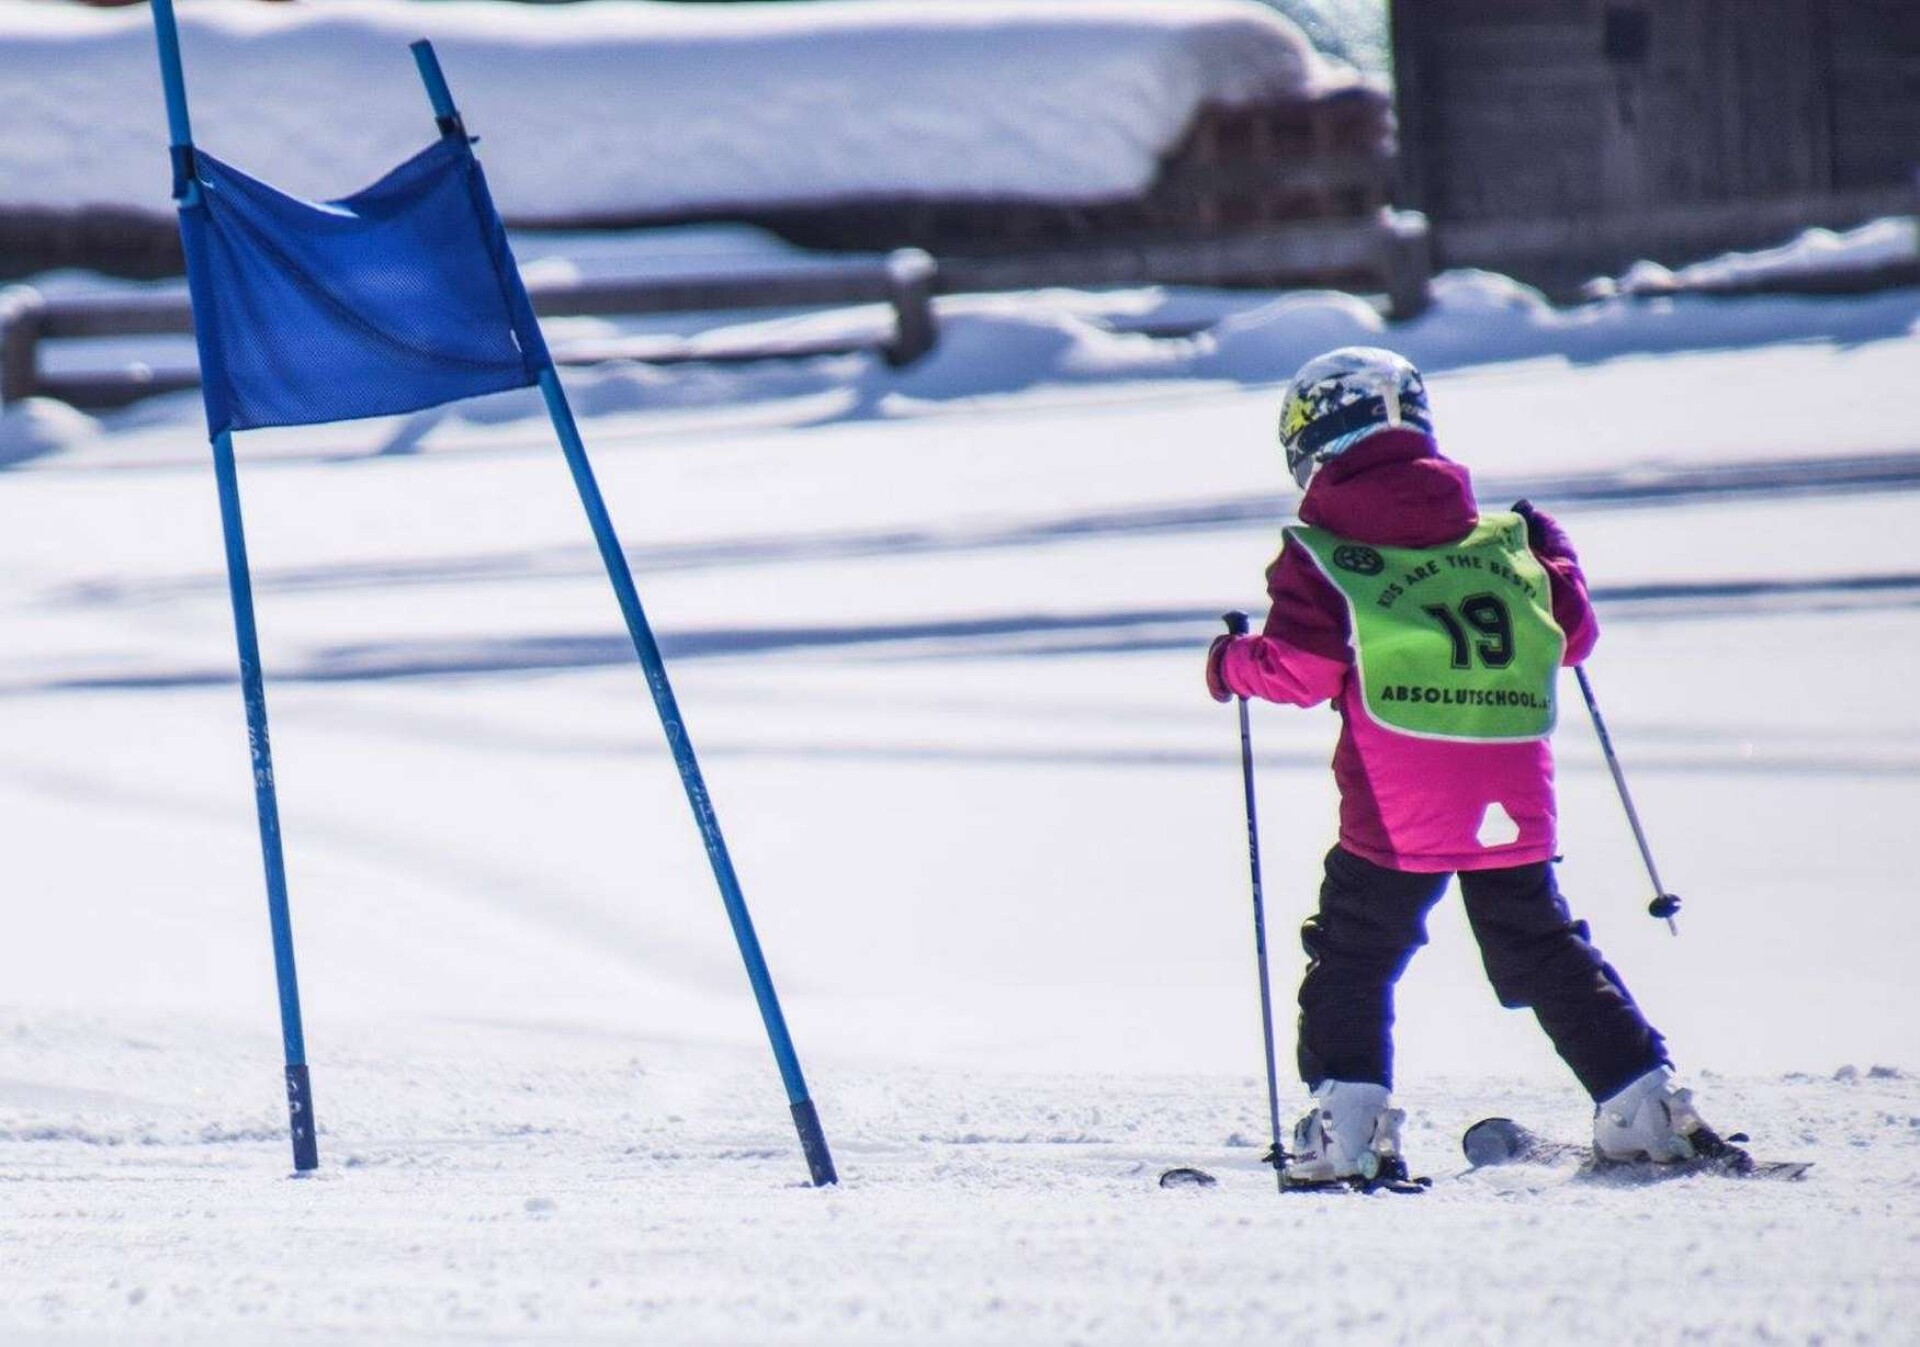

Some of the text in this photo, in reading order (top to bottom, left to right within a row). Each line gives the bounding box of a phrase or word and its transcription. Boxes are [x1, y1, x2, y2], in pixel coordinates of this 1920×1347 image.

[1406, 560, 1440, 586] ARE
[1446, 555, 1482, 569] THE
[1421, 591, 1516, 669] 19
